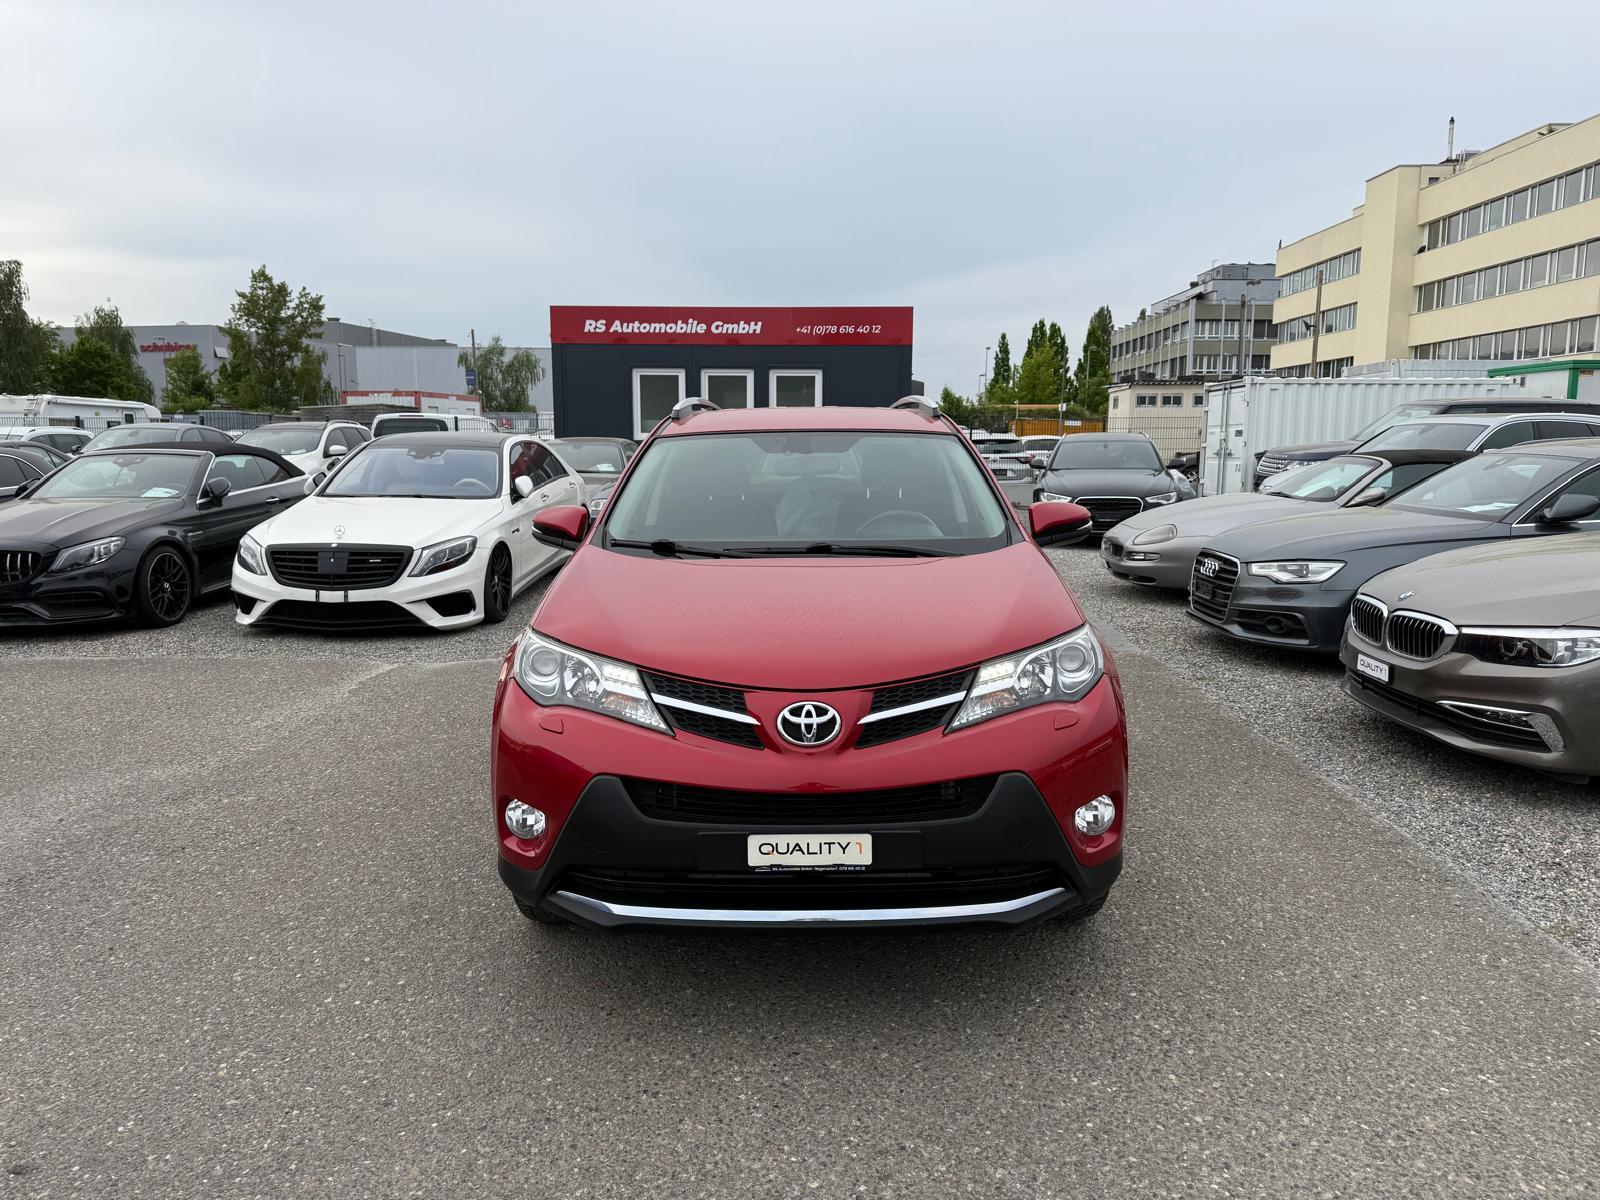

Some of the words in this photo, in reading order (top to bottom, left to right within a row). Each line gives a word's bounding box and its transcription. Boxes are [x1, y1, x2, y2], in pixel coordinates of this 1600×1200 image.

[584, 319, 606, 333] RS
[609, 318, 707, 334] Automobile
[710, 320, 762, 334] GmbH
[795, 325, 811, 334] +41
[813, 324, 838, 336] (0)78
[839, 325, 855, 334] 616
[856, 325, 870, 334] 40
[871, 324, 882, 334] 12
